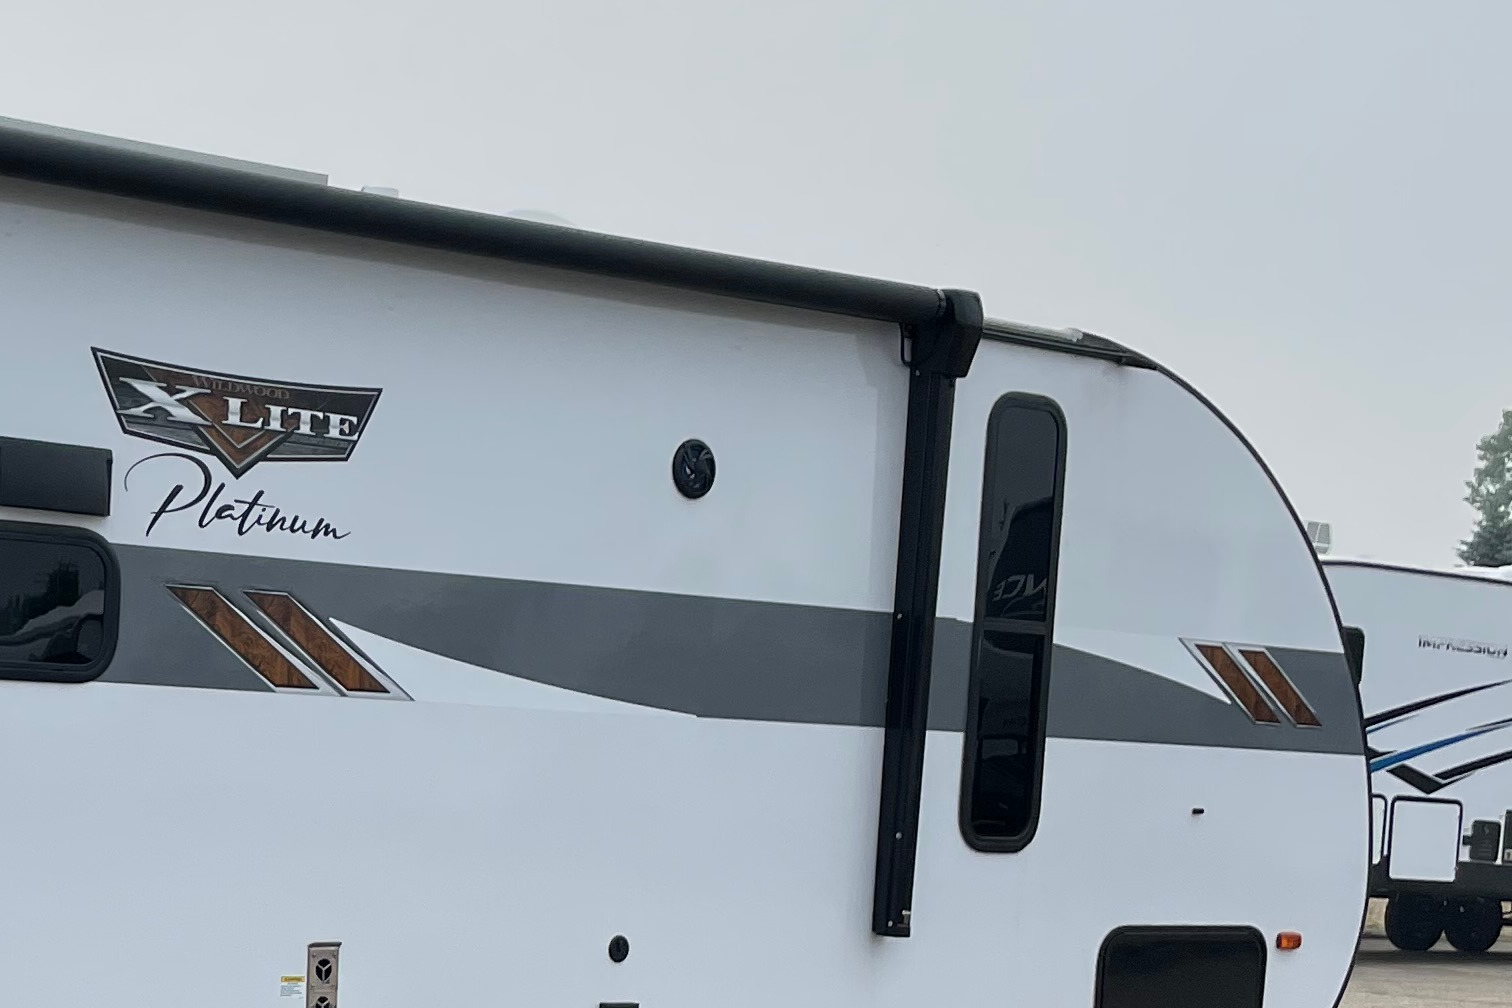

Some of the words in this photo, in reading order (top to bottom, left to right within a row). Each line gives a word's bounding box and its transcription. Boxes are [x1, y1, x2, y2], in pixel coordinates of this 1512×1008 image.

[117, 376, 214, 426] X
[222, 396, 359, 441] LITE
[192, 375, 290, 400] WILDWOOD
[124, 452, 351, 540] Platinum
